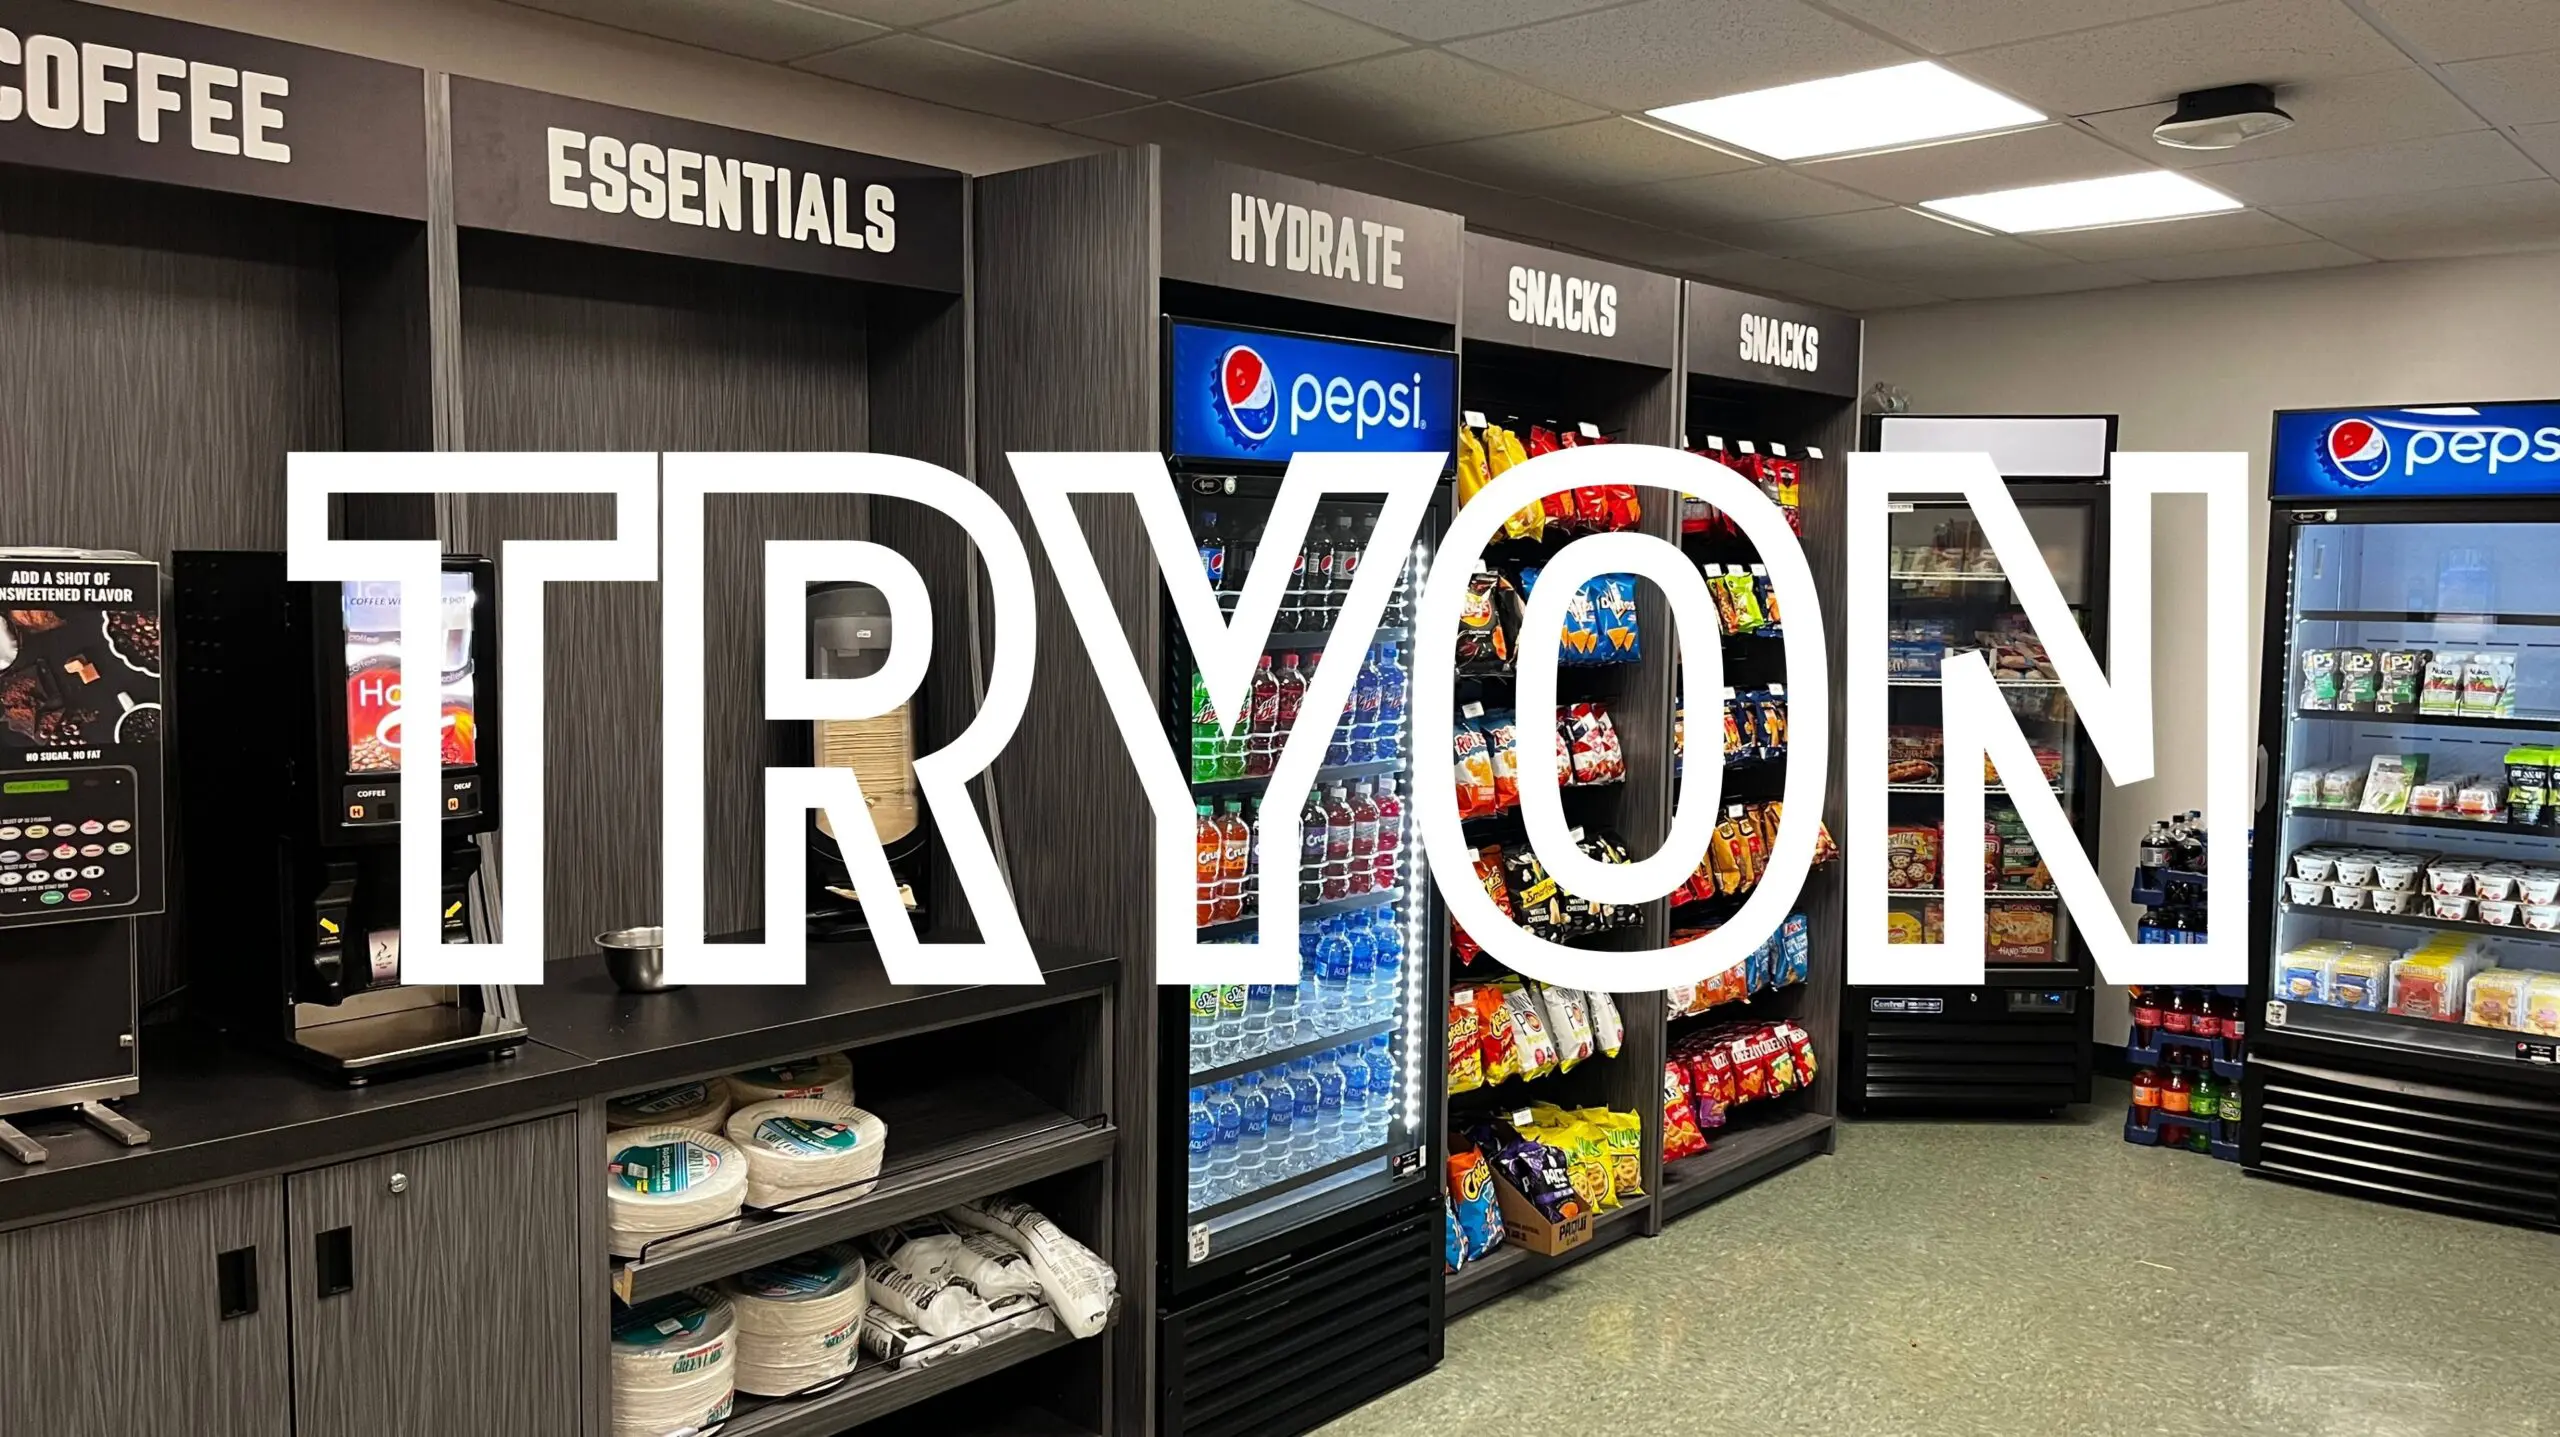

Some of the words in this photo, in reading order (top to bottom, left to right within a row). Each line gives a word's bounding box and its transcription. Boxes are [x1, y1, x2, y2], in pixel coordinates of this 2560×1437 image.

[0, 28, 290, 164] COFFEE
[547, 127, 896, 254] ESSENTIALS
[1230, 192, 1404, 290] HYDRATE
[1508, 265, 1618, 338] SNACKS
[1739, 313, 1818, 373] SNACKS
[1291, 372, 1422, 440] pepsi
[2404, 426, 2560, 476] peps
[11, 571, 40, 585] ADD
[43, 572, 53, 585] A
[56, 571, 91, 586] SHOT
[94, 572, 111, 586] OF
[0, 587, 81, 602] NSWEETENED
[84, 588, 134, 603] FLAVOR
[350, 597, 386, 606] COFFEE
[2313, 653, 2334, 669] P3
[2353, 653, 2374, 669] P3
[2391, 654, 2414, 671] P3
[26, 753, 38, 761] NO
[40, 752, 72, 761] SUGAR,
[73, 751, 84, 760] NO
[87, 750, 101, 759] FAT
[357, 790, 386, 798] COFFEE
[454, 782, 472, 790] DECAF
[352, 808, 361, 816] H
